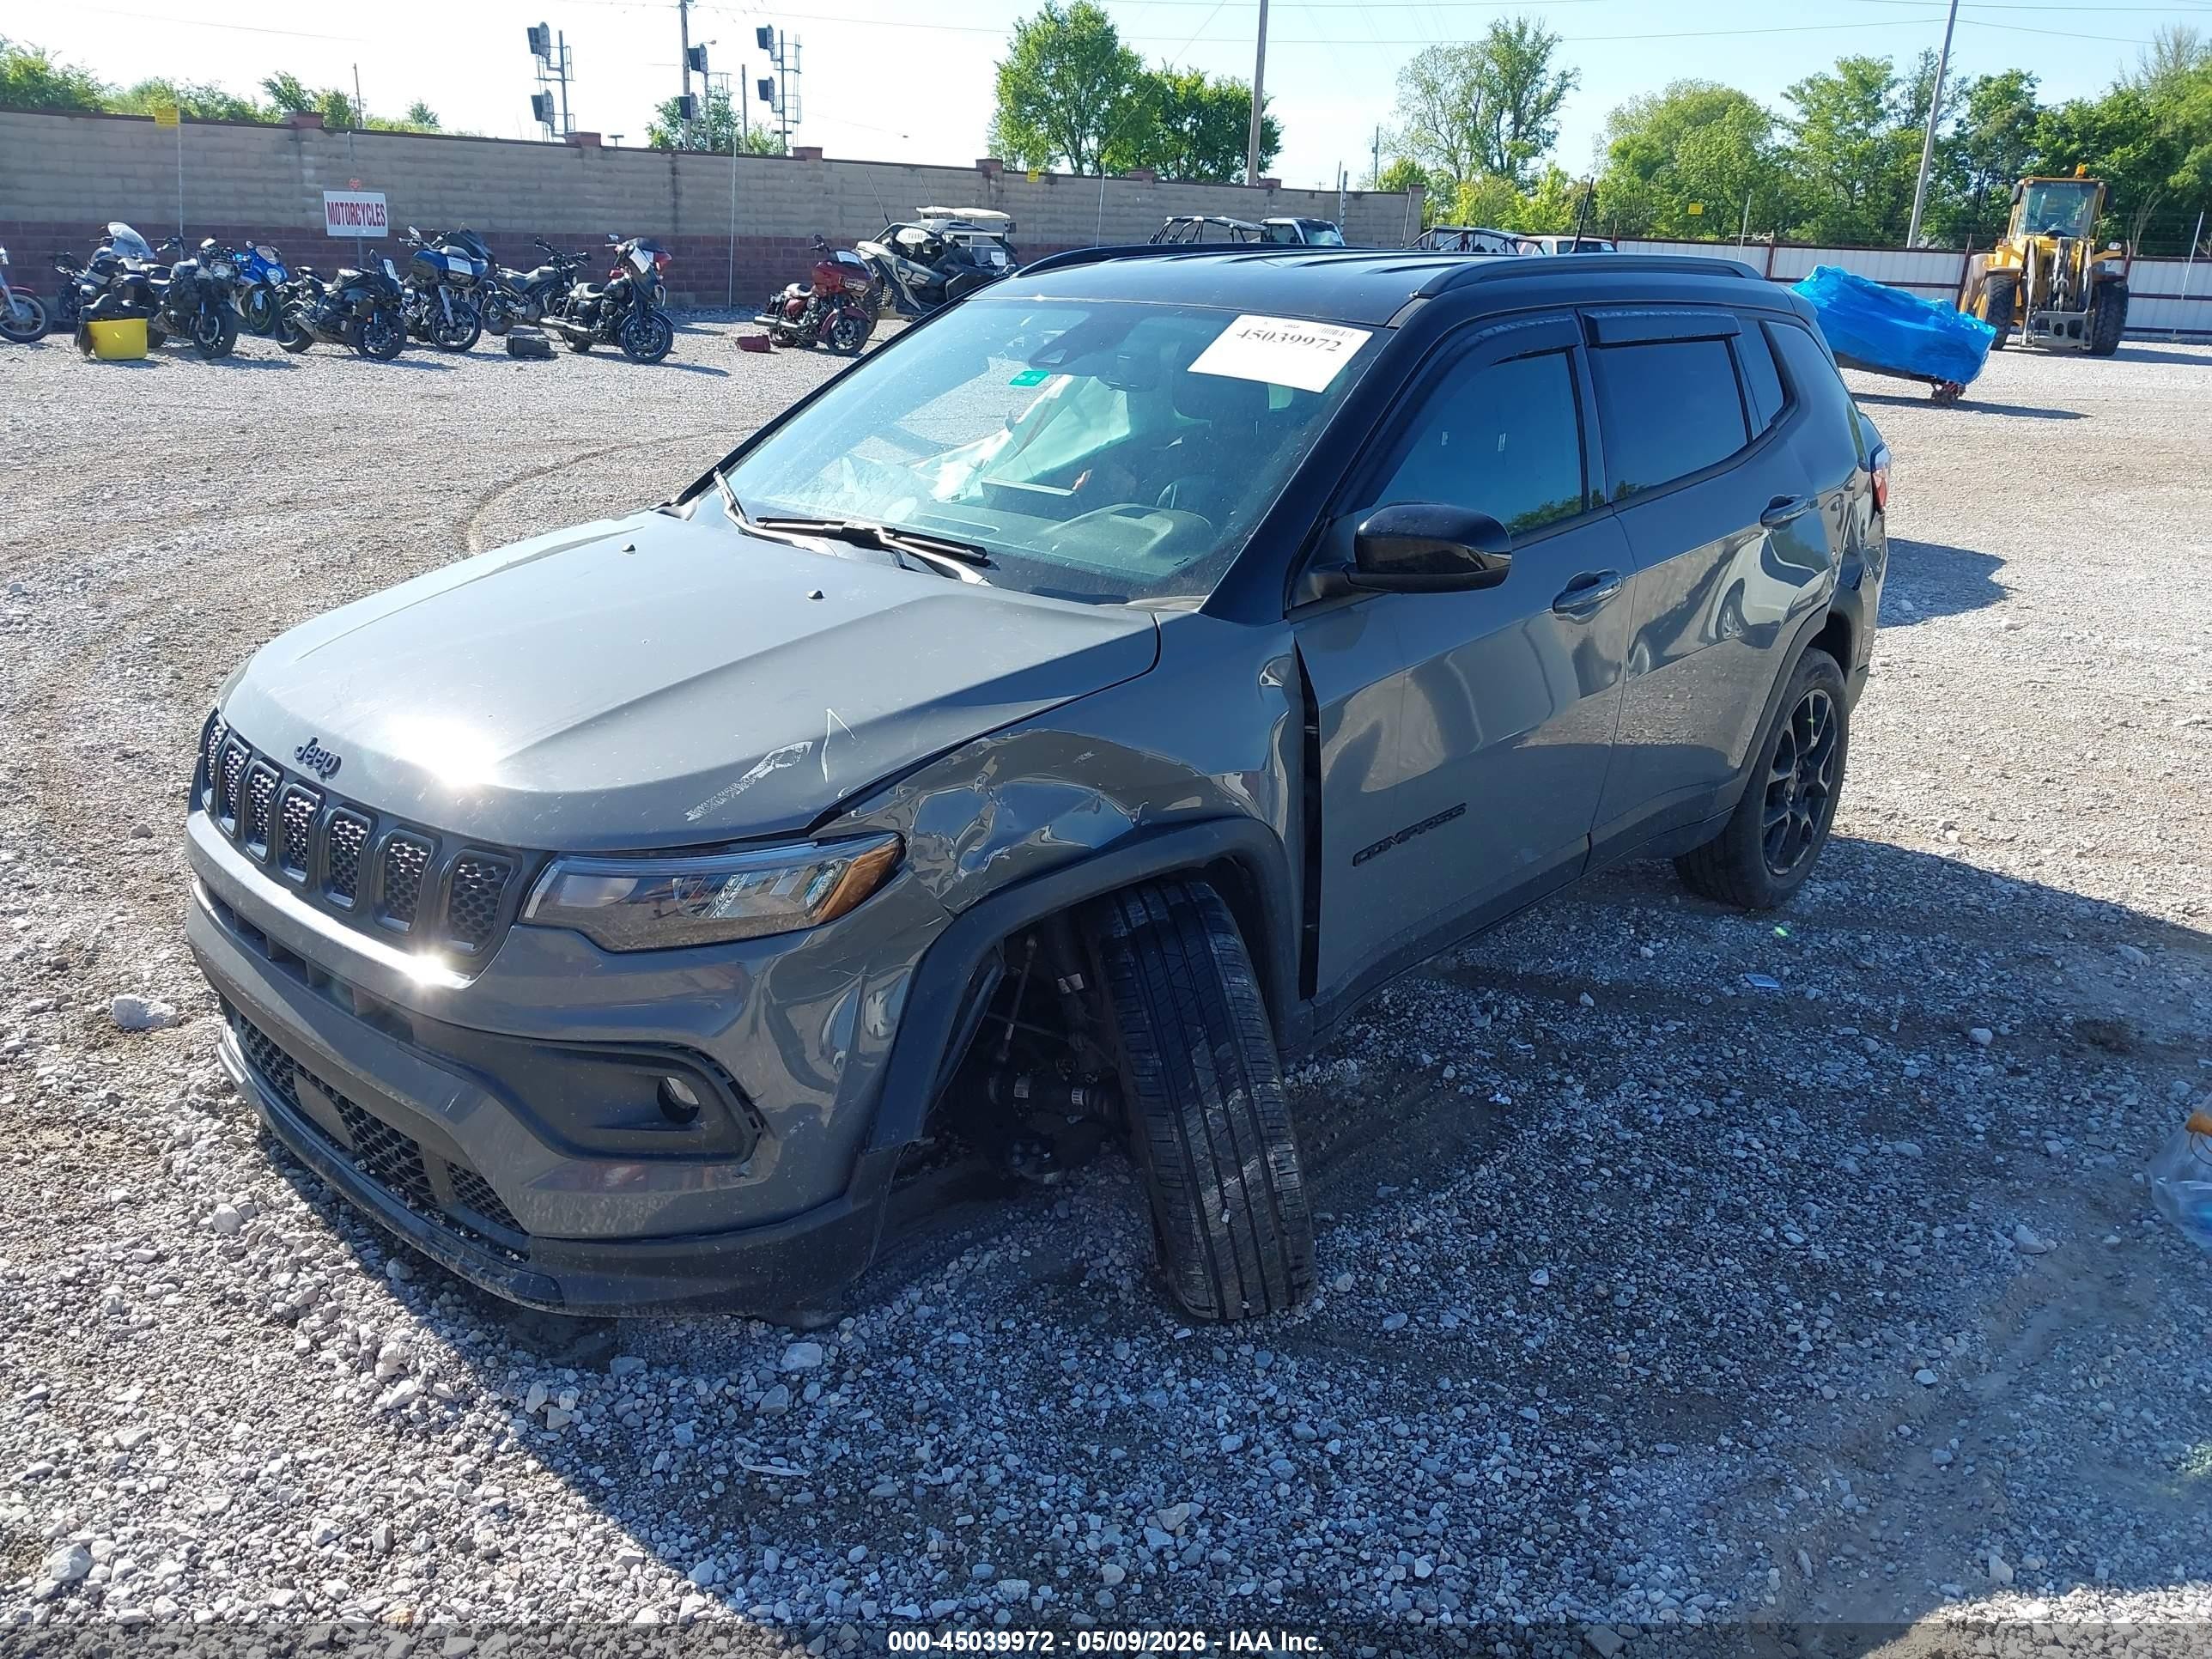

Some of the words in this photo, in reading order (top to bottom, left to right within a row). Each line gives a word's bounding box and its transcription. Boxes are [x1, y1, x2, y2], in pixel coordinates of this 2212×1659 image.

[326, 202, 386, 227] MOTORCYCLES
[1237, 328, 1342, 352] 45039972
[295, 736, 342, 782] Jeep
